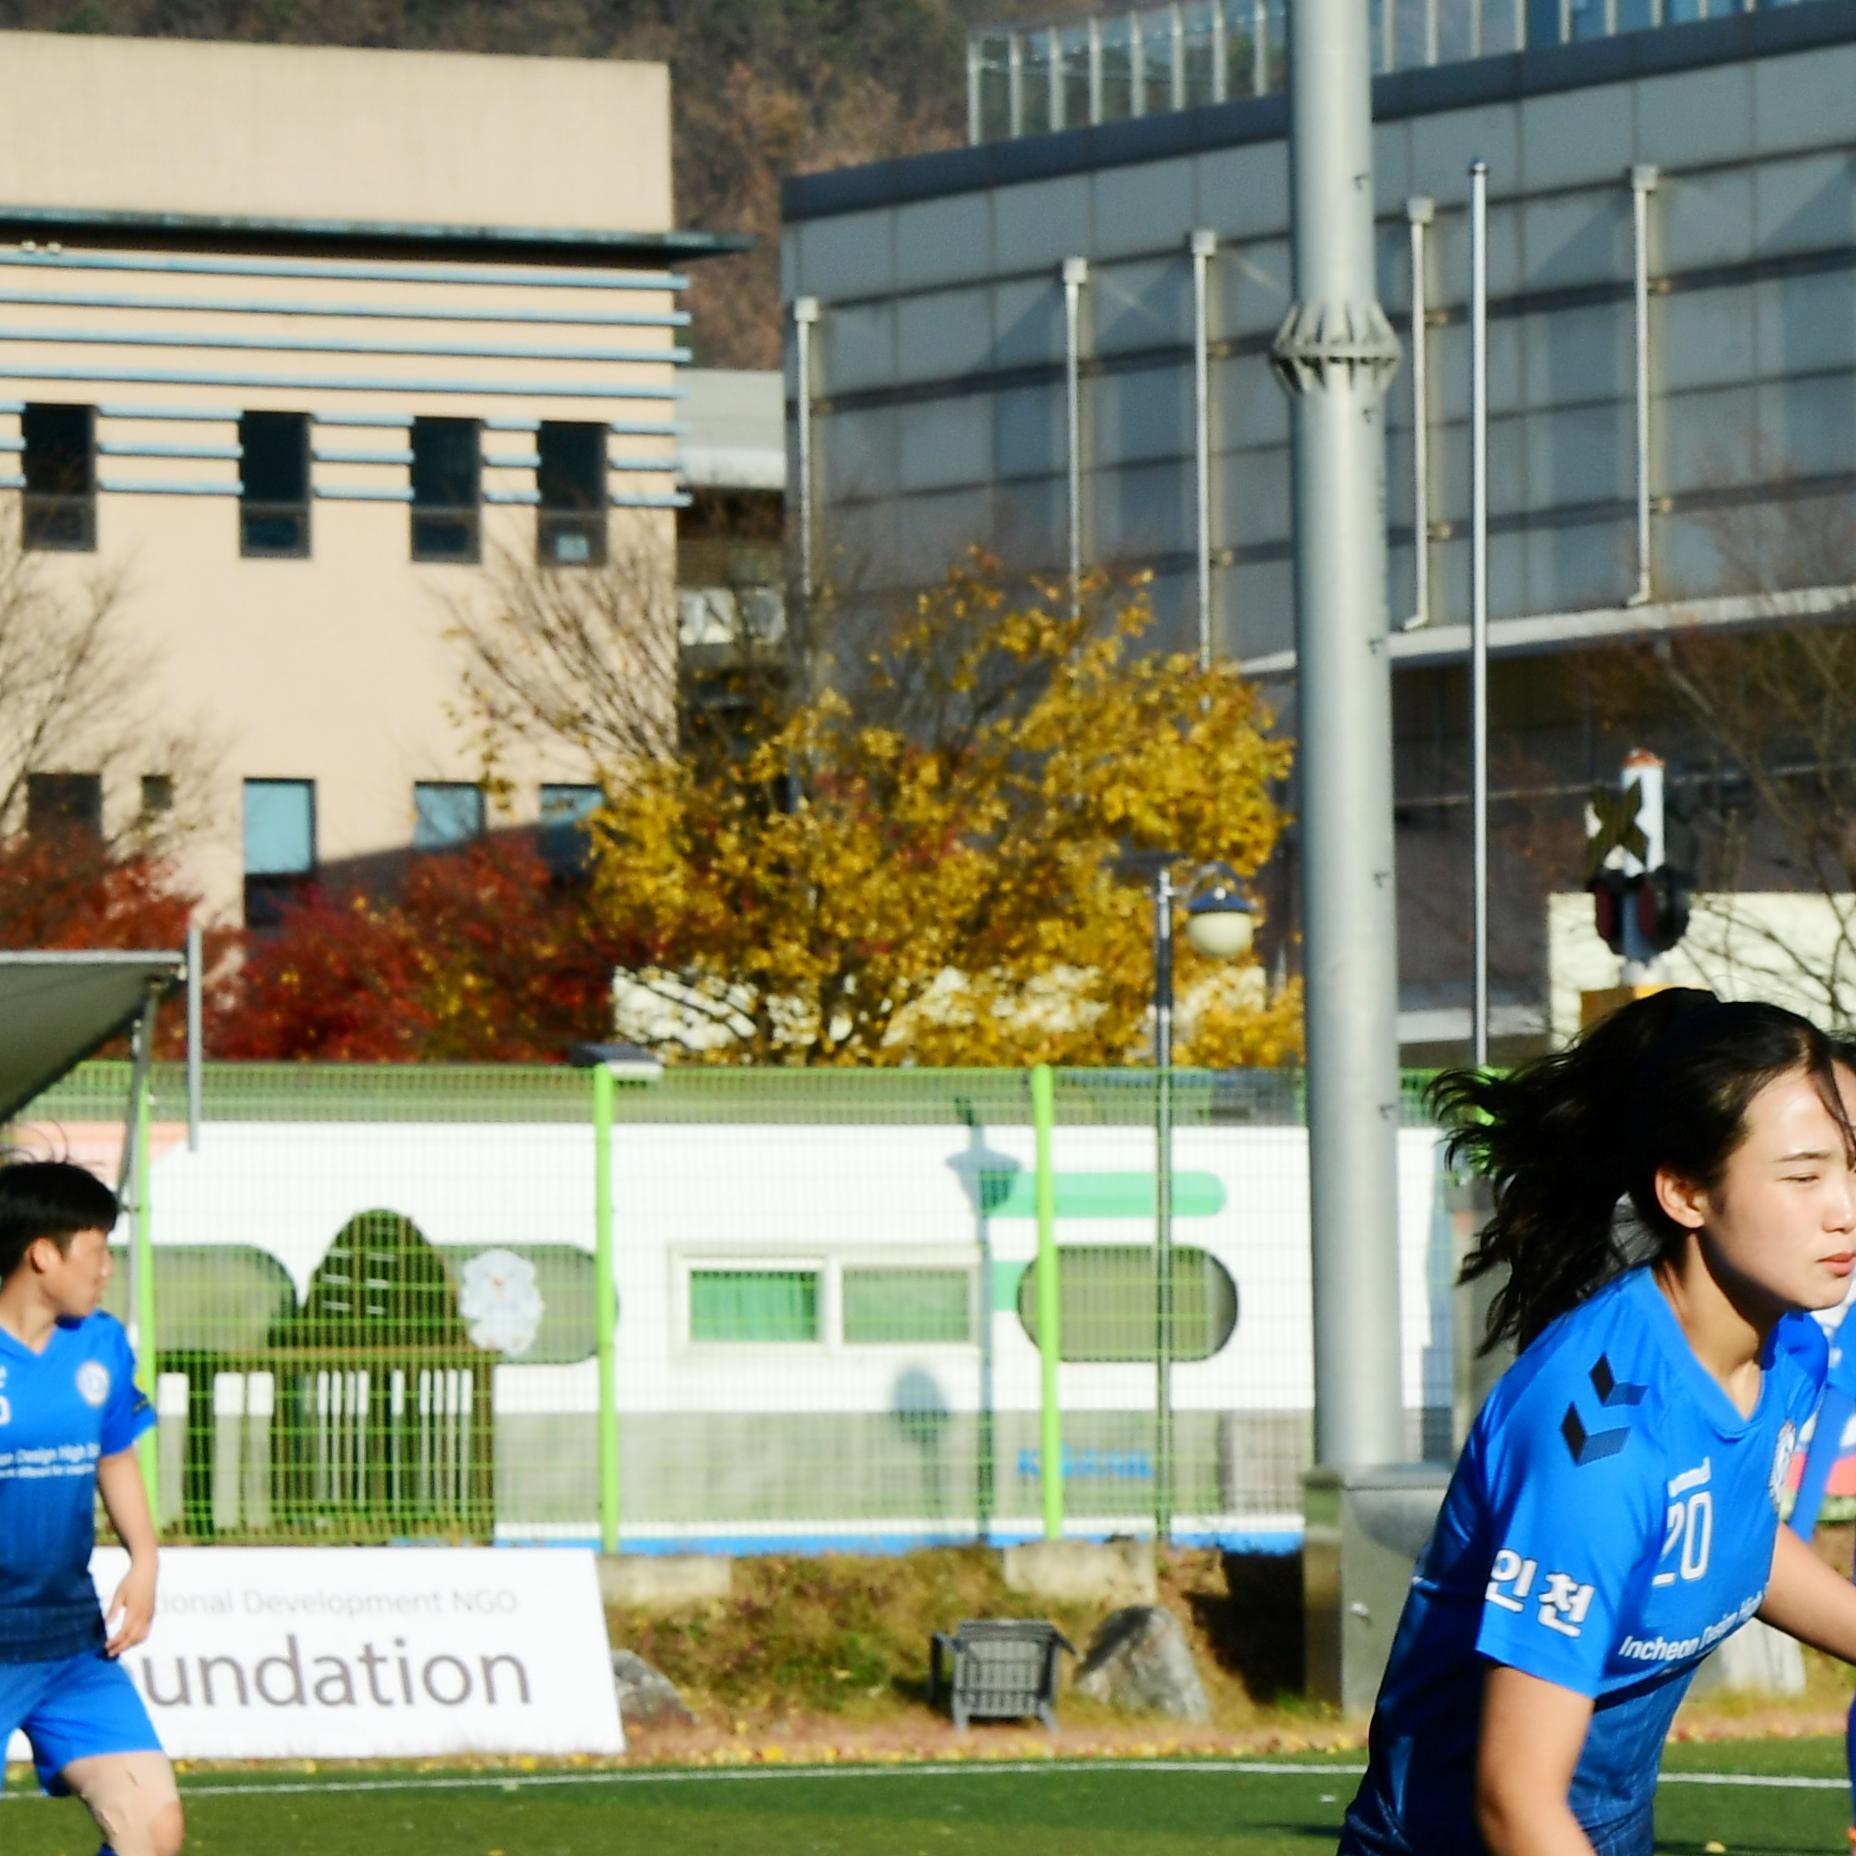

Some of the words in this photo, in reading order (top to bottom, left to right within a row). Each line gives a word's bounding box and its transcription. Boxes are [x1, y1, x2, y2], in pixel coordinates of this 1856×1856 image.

[1652, 1491, 1713, 1587] 20
[243, 1587, 443, 1618] Development
[453, 1588, 518, 1614] NGO
[1484, 1548, 1596, 1638] 인천
[1618, 1635, 1700, 1661] Incheon
